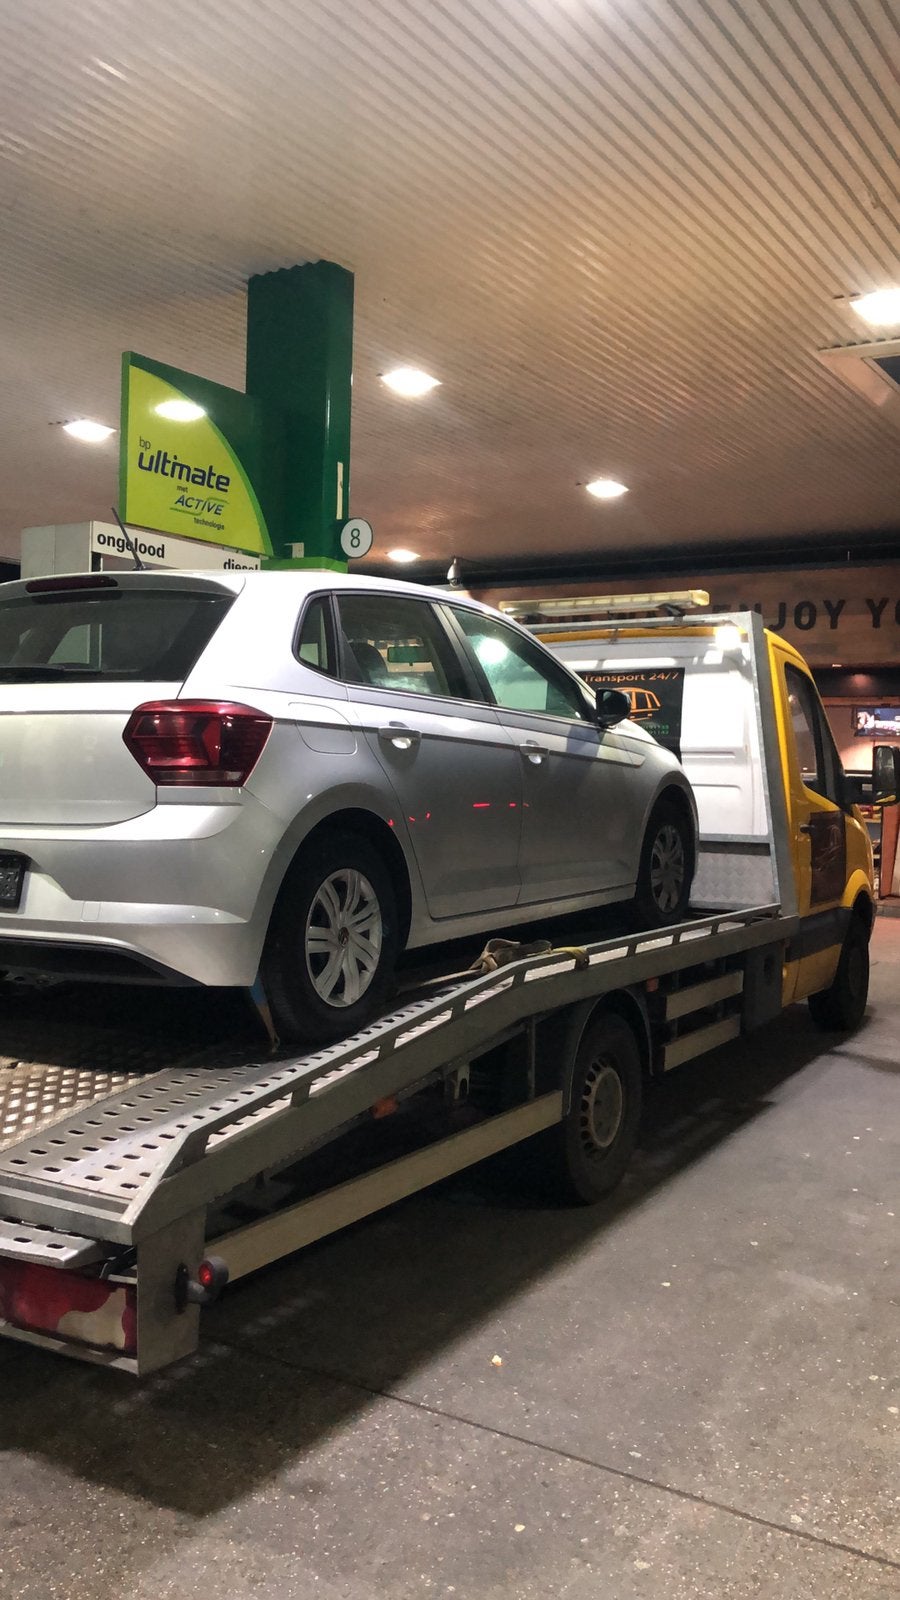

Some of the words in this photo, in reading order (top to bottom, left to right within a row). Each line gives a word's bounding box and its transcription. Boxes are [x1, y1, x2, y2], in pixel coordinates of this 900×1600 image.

[139, 436, 151, 451] bp
[138, 450, 230, 493] ultimate
[177, 485, 188, 493] met
[175, 495, 224, 515] ACTIVE
[350, 528, 360, 548] 8
[865, 597, 900, 629] Y
[585, 674, 645, 683] Transport
[649, 672, 679, 681] 24/7
